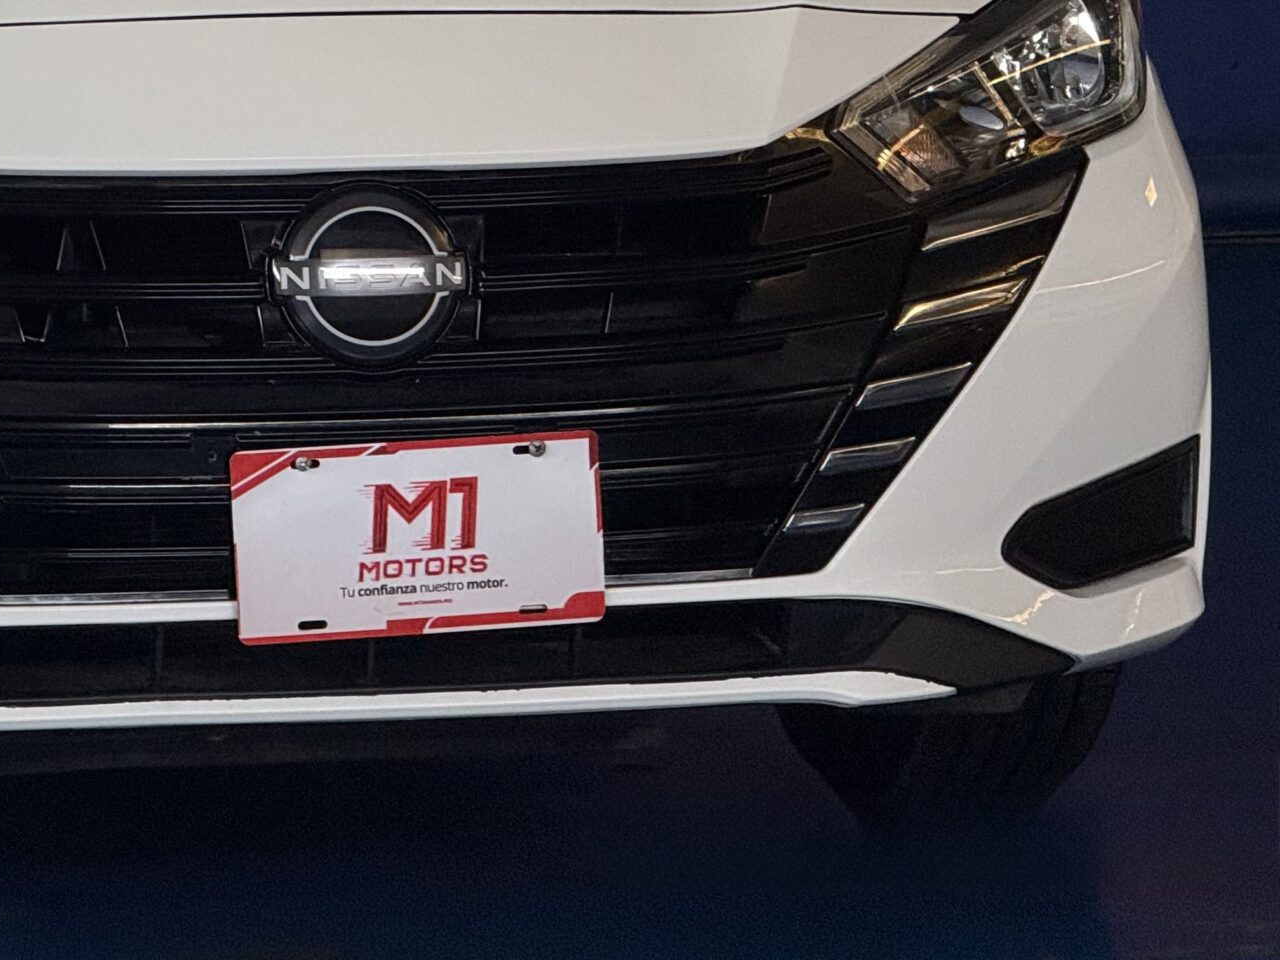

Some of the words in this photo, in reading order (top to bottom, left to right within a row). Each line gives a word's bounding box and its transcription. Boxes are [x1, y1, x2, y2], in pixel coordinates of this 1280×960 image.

[279, 261, 463, 290] NISSAN
[360, 476, 478, 555] M1
[357, 553, 489, 583] MOTORS
[340, 587, 356, 599] Tu
[357, 583, 417, 597] confianza
[419, 580, 465, 594] nuestro
[466, 577, 509, 590] motor.
